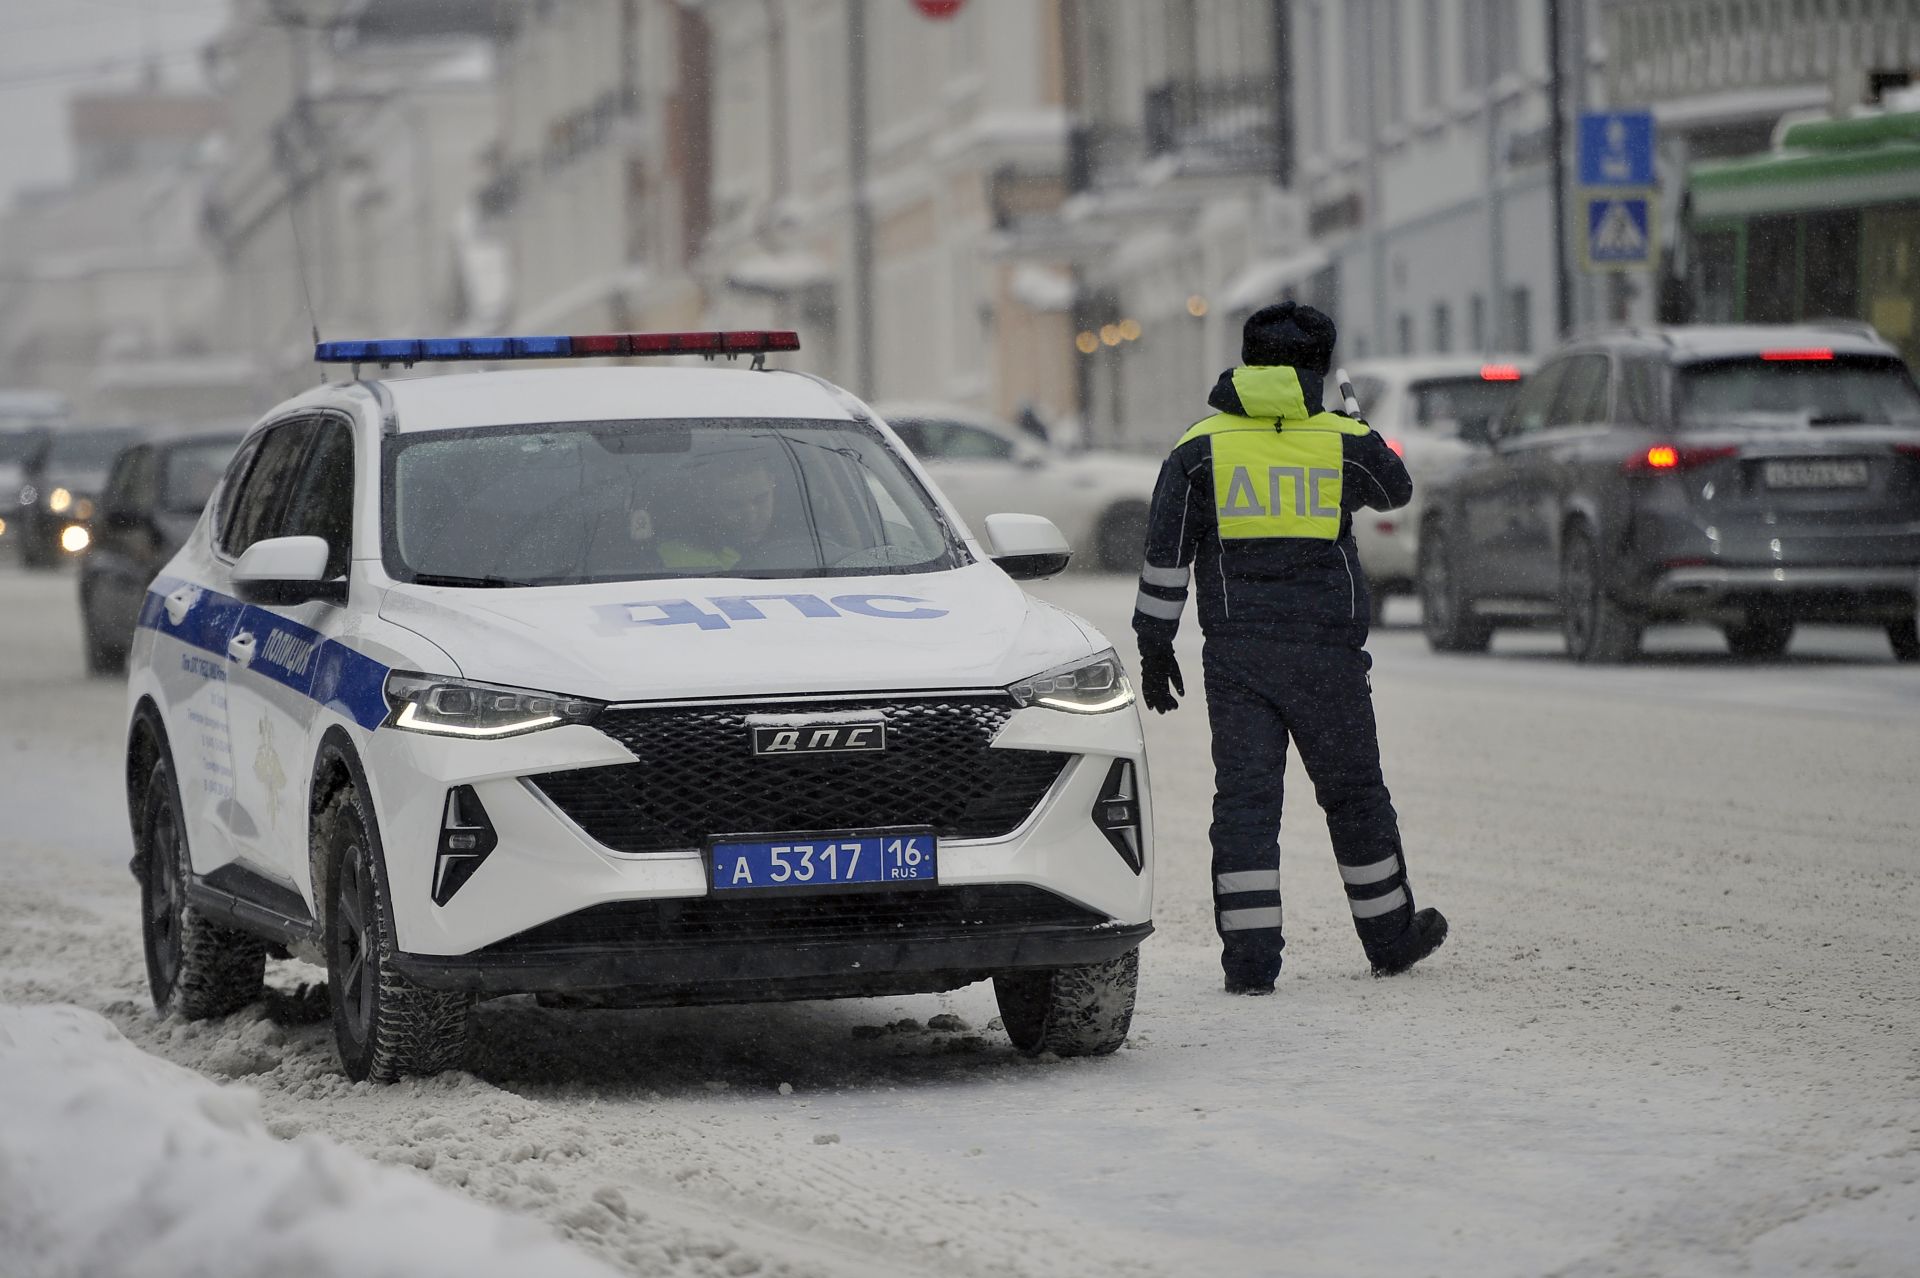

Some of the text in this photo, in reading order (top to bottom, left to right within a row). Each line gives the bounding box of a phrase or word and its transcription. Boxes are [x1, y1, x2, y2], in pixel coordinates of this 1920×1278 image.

[1219, 465, 1340, 518] ДПС
[589, 593, 950, 637] ДПС
[261, 627, 314, 677] ПОЛИЦИЯ
[765, 728, 874, 751] ДПС
[732, 838, 922, 884] А 5317 16
[891, 867, 918, 879] RUS
